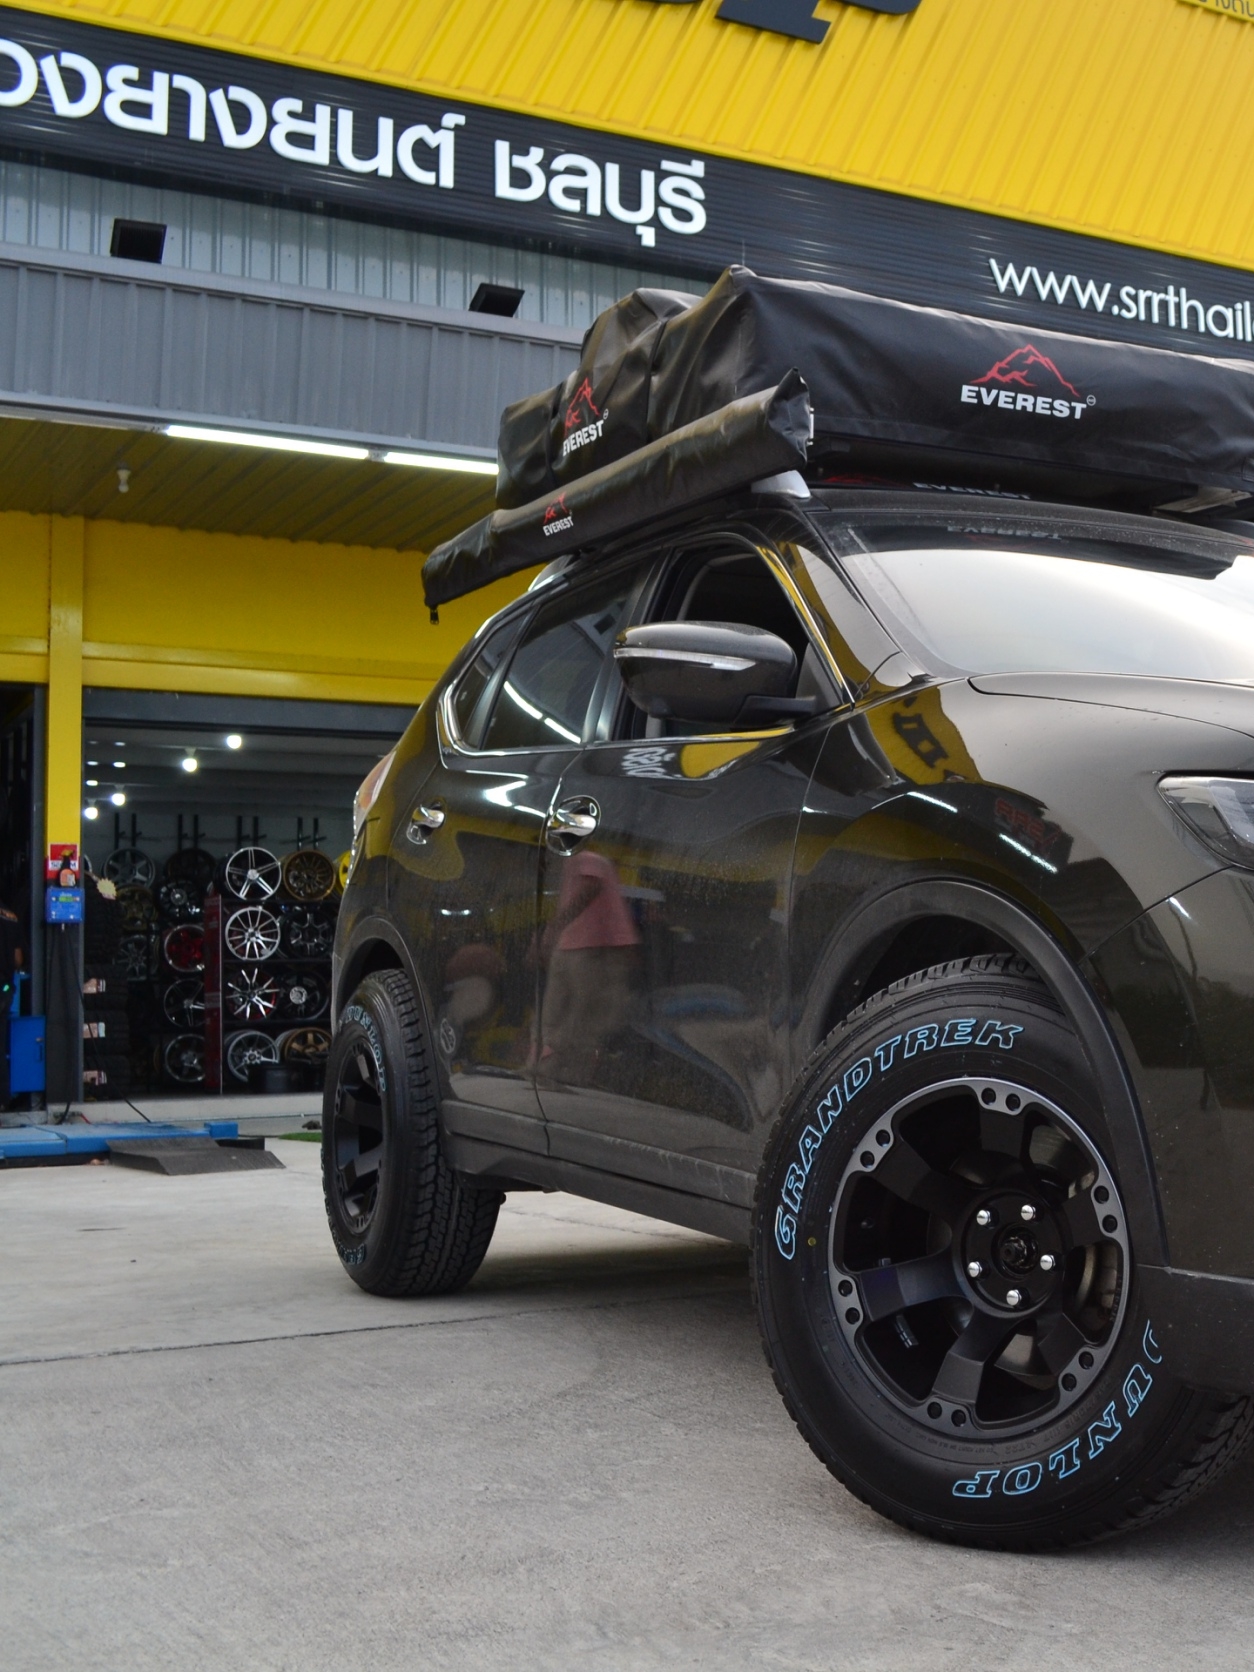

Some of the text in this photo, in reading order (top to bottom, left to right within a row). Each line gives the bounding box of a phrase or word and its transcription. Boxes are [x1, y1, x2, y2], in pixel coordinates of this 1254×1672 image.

[495, 139, 707, 247] ชลบุรี
[960, 384, 1087, 420] EVEREST
[562, 419, 605, 457] EVEREST
[543, 516, 575, 536] EVEREST
[774, 1018, 1025, 1260] GRANDTREK
